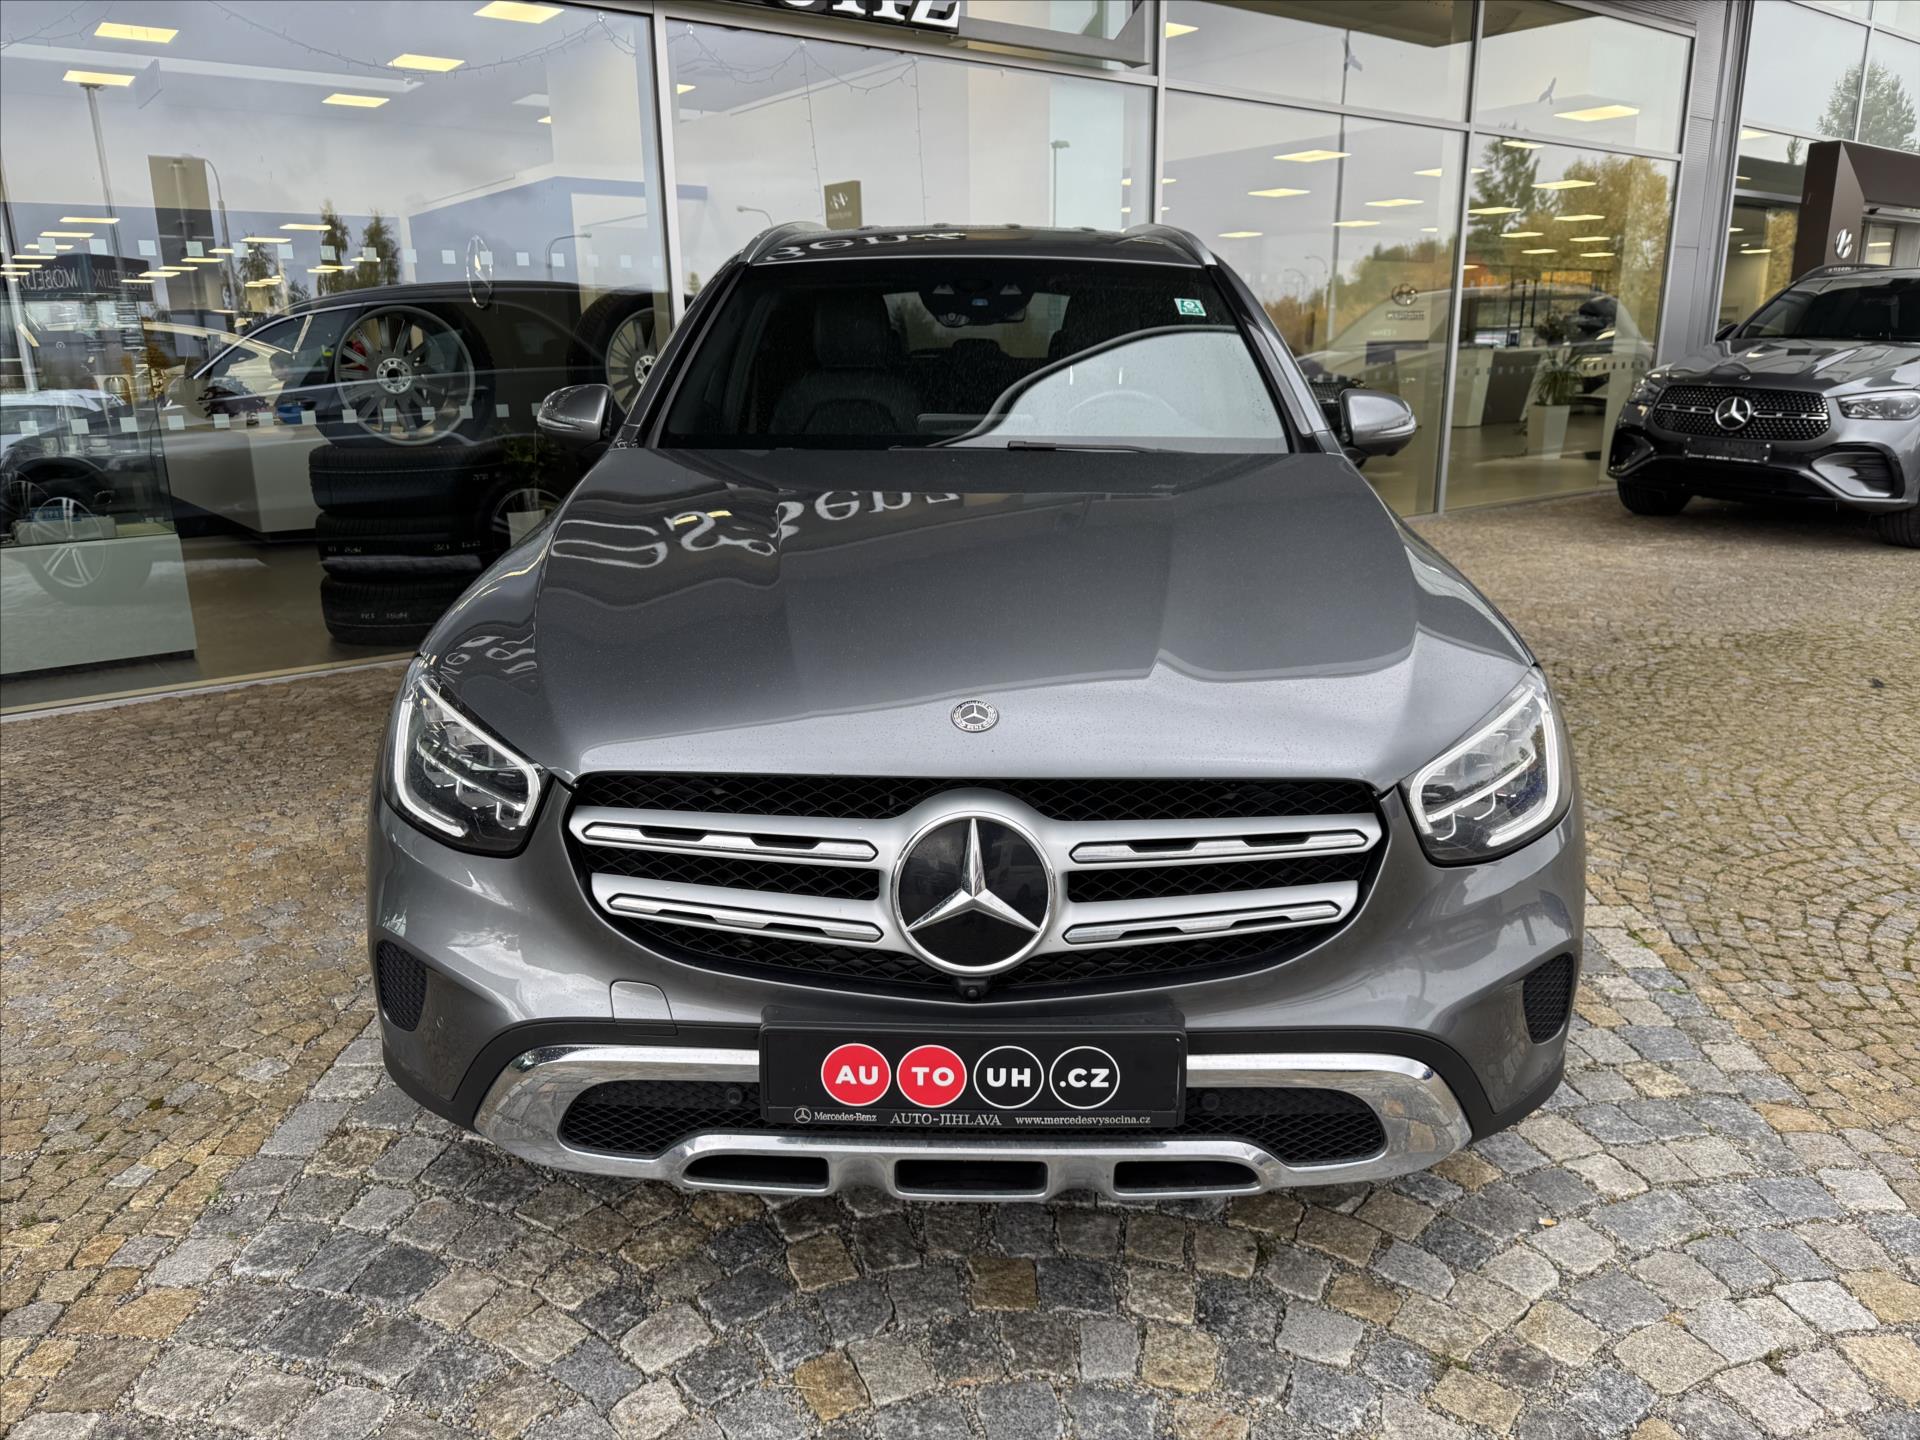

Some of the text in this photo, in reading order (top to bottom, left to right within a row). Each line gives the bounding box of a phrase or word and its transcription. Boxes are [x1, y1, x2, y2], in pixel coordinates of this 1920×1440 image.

[814, 1111, 1151, 1127] Mercedes-Benz AUTO-JIHLAVA www.mercedesvysocina.cz
